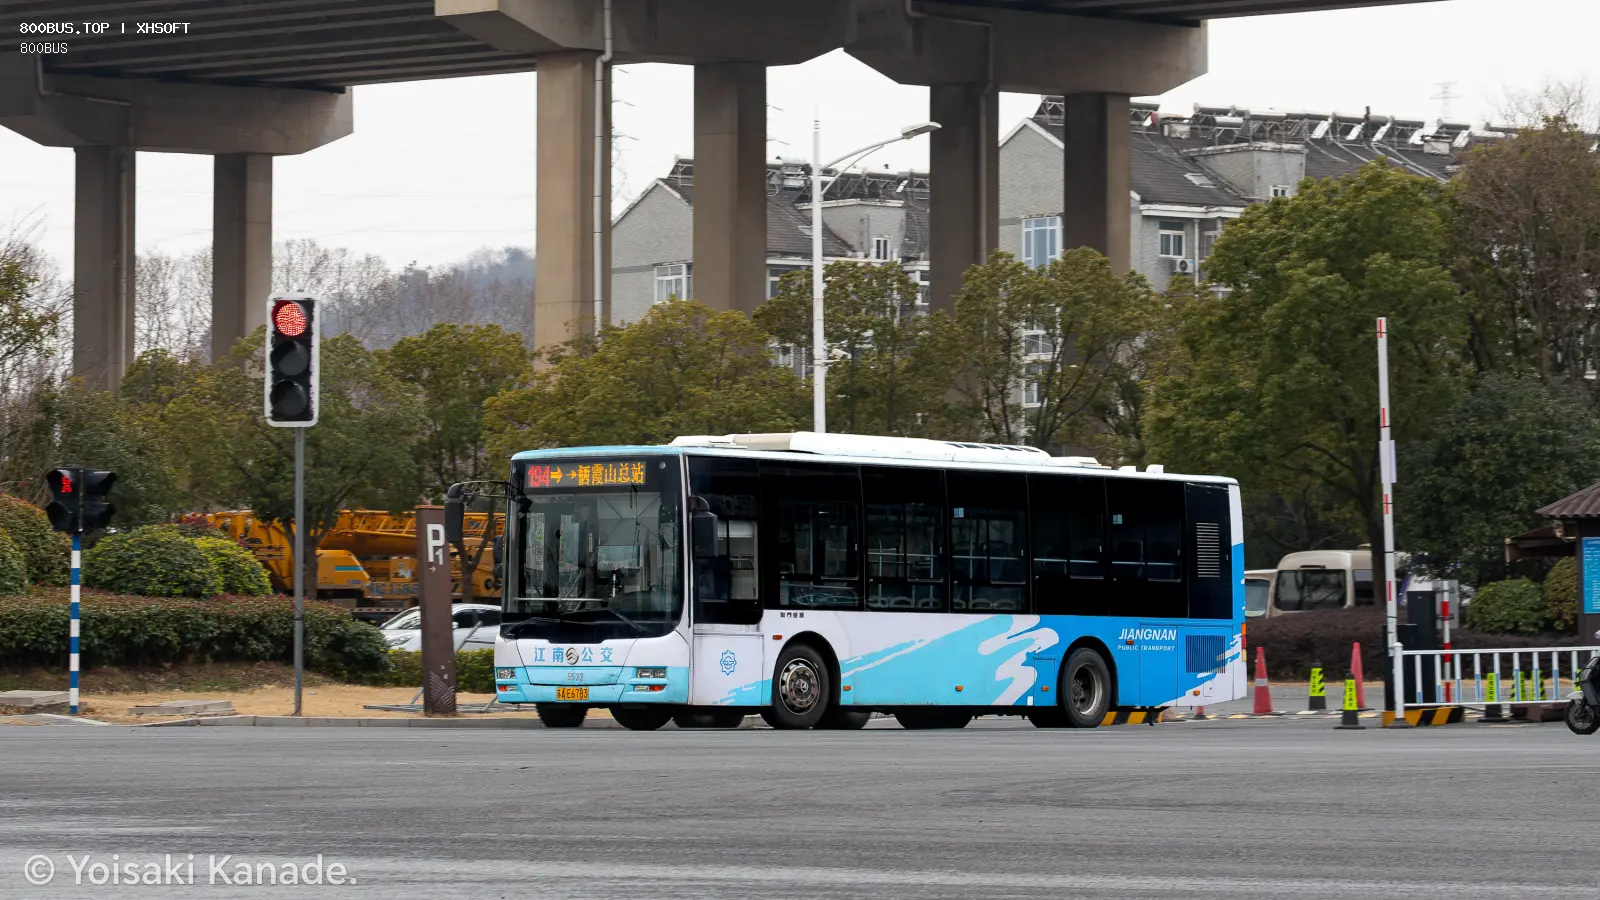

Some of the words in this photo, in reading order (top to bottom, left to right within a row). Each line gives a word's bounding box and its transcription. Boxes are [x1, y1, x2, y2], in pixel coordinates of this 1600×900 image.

[527, 465, 550, 488] 194
[577, 462, 645, 486] 栖霞山总站
[1118, 628, 1177, 641] JIANGNAN
[567, 672, 584, 682] 5532
